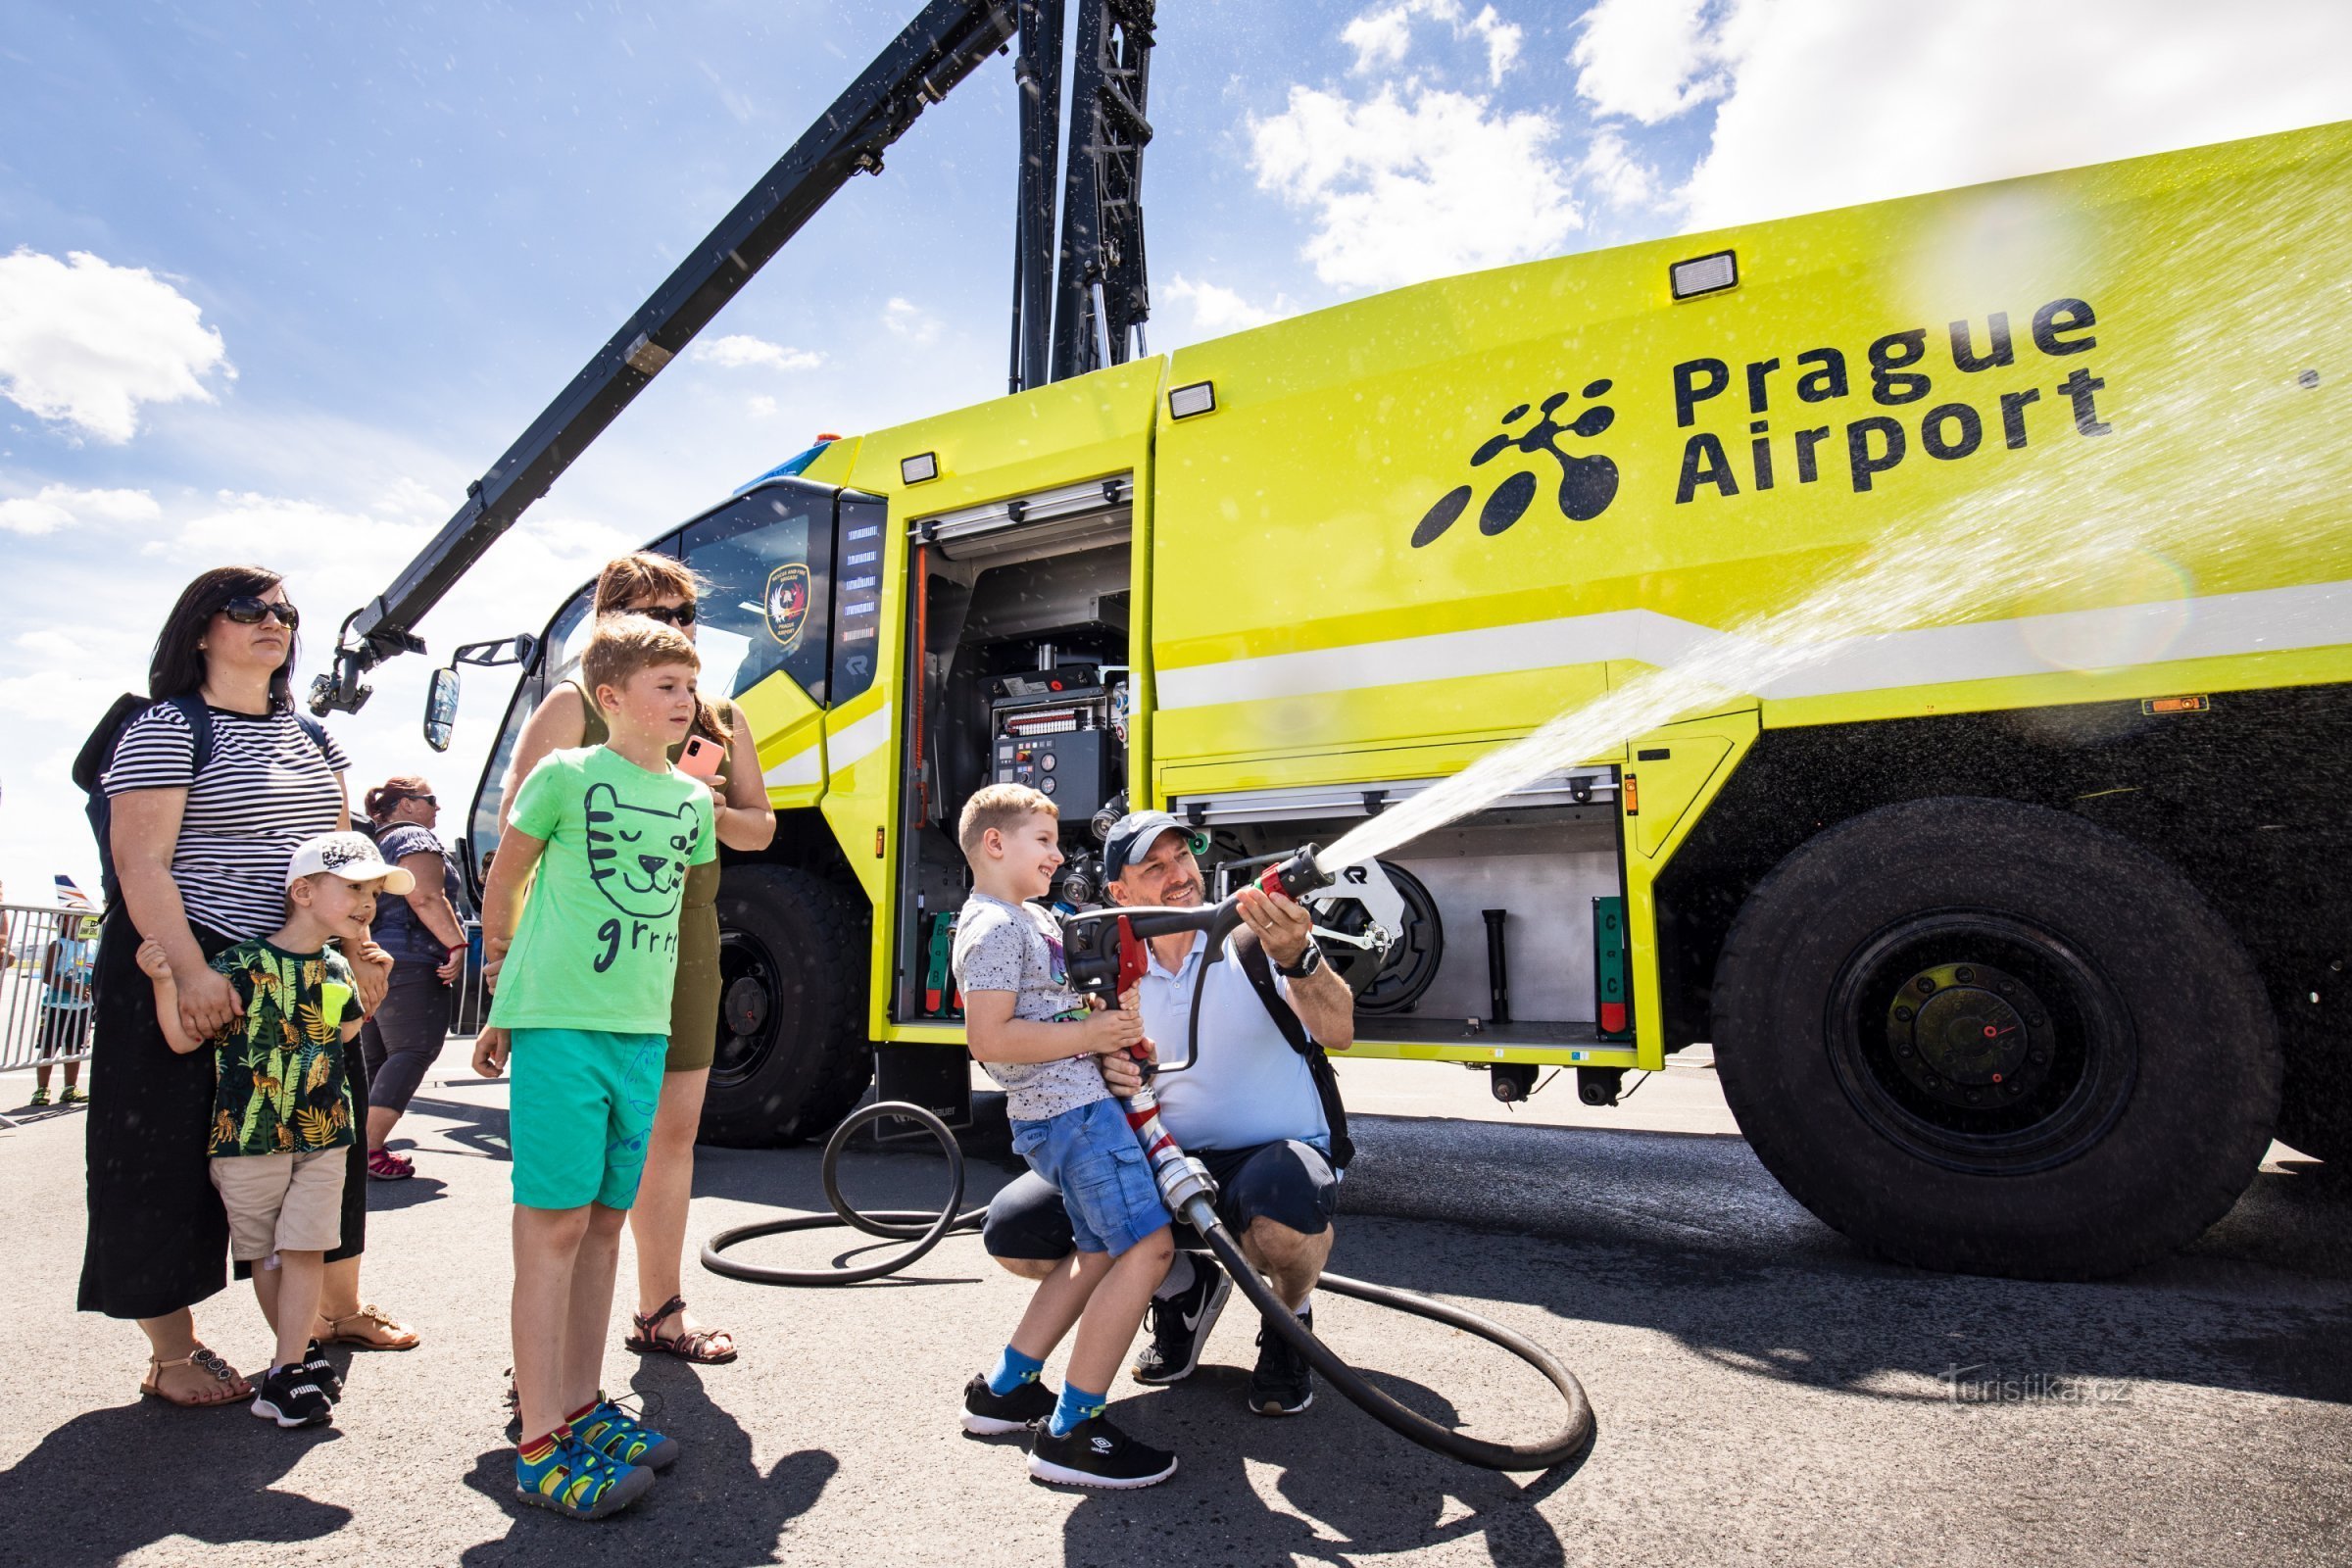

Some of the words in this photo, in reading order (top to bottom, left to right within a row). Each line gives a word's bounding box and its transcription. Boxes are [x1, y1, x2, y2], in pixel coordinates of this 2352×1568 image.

[1673, 297, 2097, 428] Prague
[1675, 368, 2113, 505] Airport
[593, 918, 678, 973] grrr!
[1605, 914, 1617, 930] C
[1607, 977, 1618, 994] C
